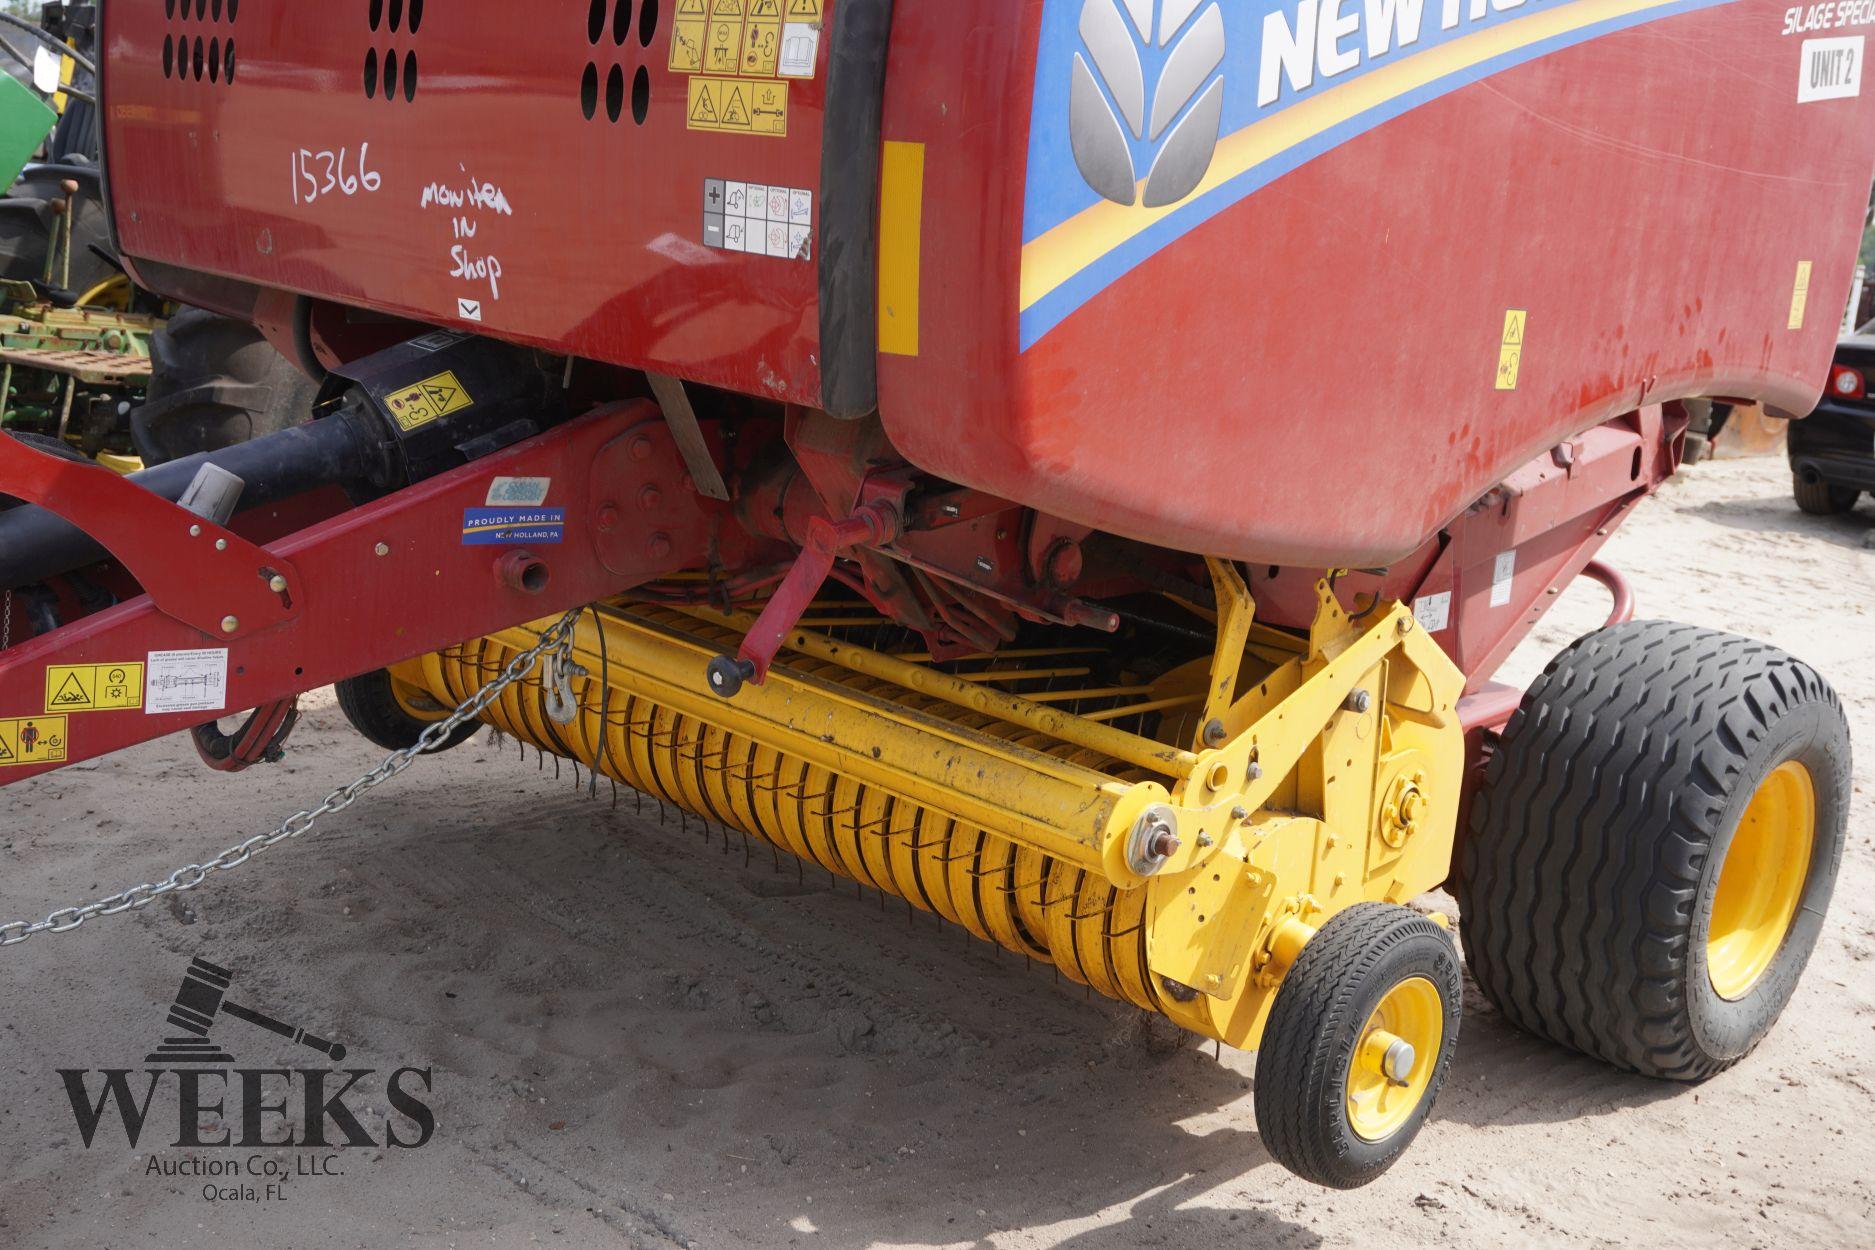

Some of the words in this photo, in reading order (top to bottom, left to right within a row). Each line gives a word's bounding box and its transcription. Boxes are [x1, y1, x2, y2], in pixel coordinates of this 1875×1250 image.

[1782, 3, 1835, 35] SILAGE
[1257, 0, 1424, 108] NEW
[1810, 49, 1843, 89] UNIT
[1844, 48, 1854, 85] 2
[292, 142, 381, 204] 15366
[450, 244, 502, 301] Shop
[468, 516, 514, 527] PROUDLY
[519, 514, 546, 522] MADE
[513, 531, 549, 539] HOLLAND,
[1433, 951, 1461, 1019] SPORT
[1329, 1008, 1363, 1158] CARLISLE
